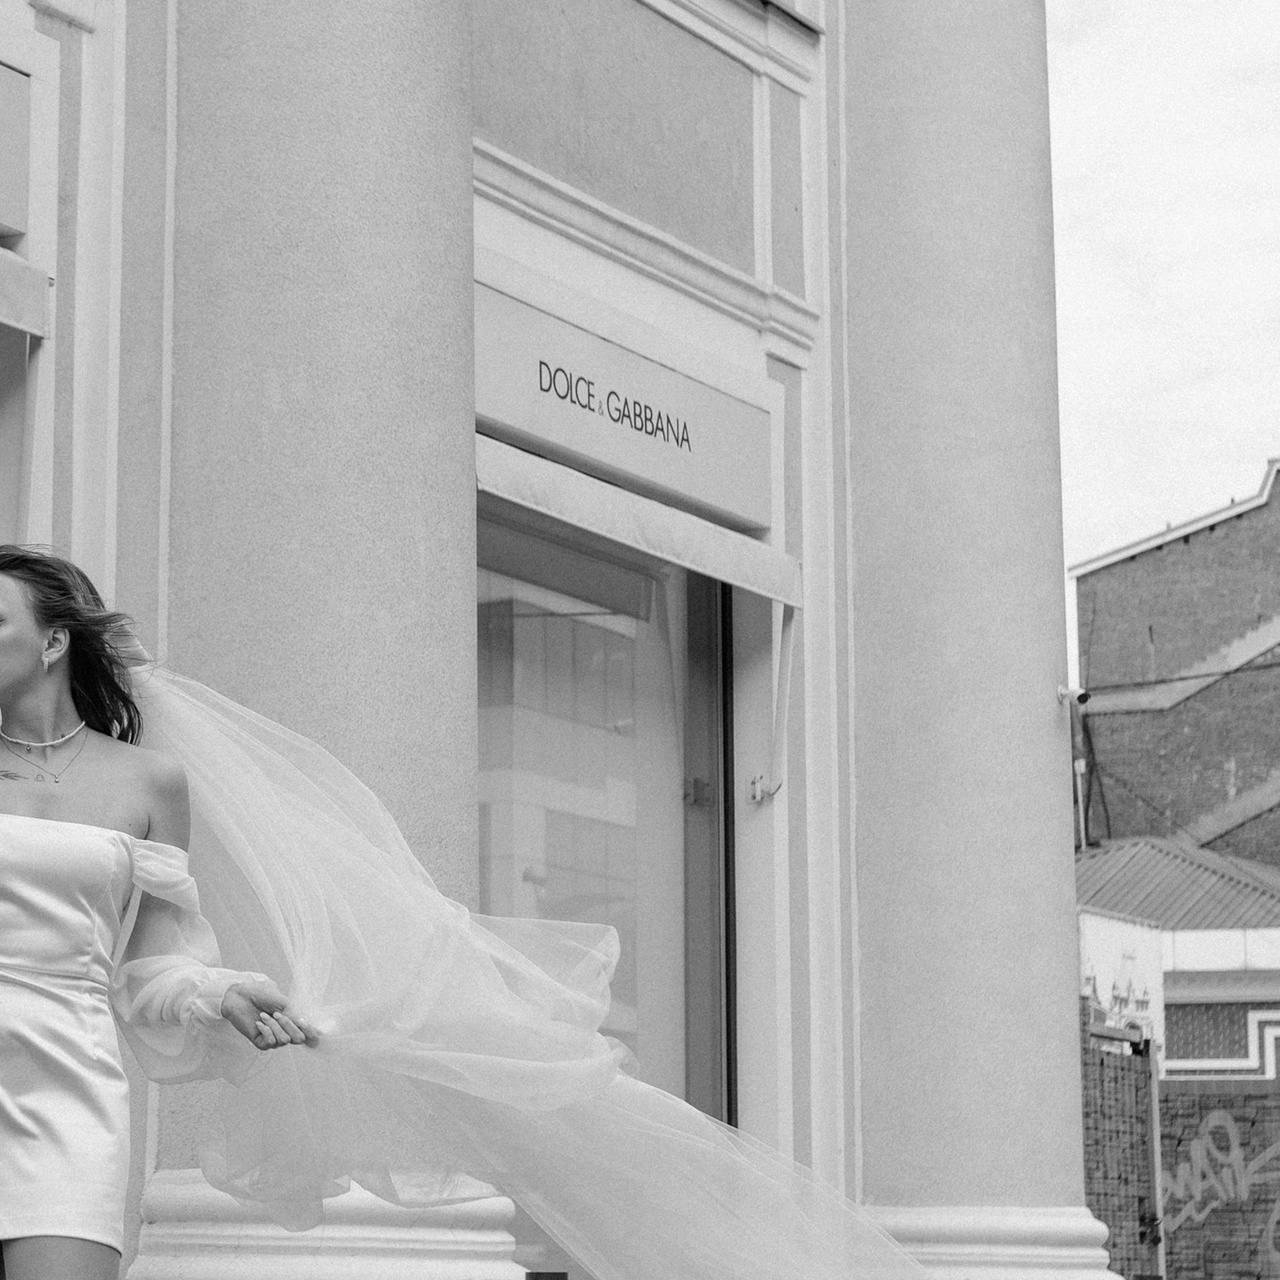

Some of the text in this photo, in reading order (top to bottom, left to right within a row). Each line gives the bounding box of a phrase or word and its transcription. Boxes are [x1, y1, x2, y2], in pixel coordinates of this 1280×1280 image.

[538, 359, 692, 453] DOLCE & GABBANA
